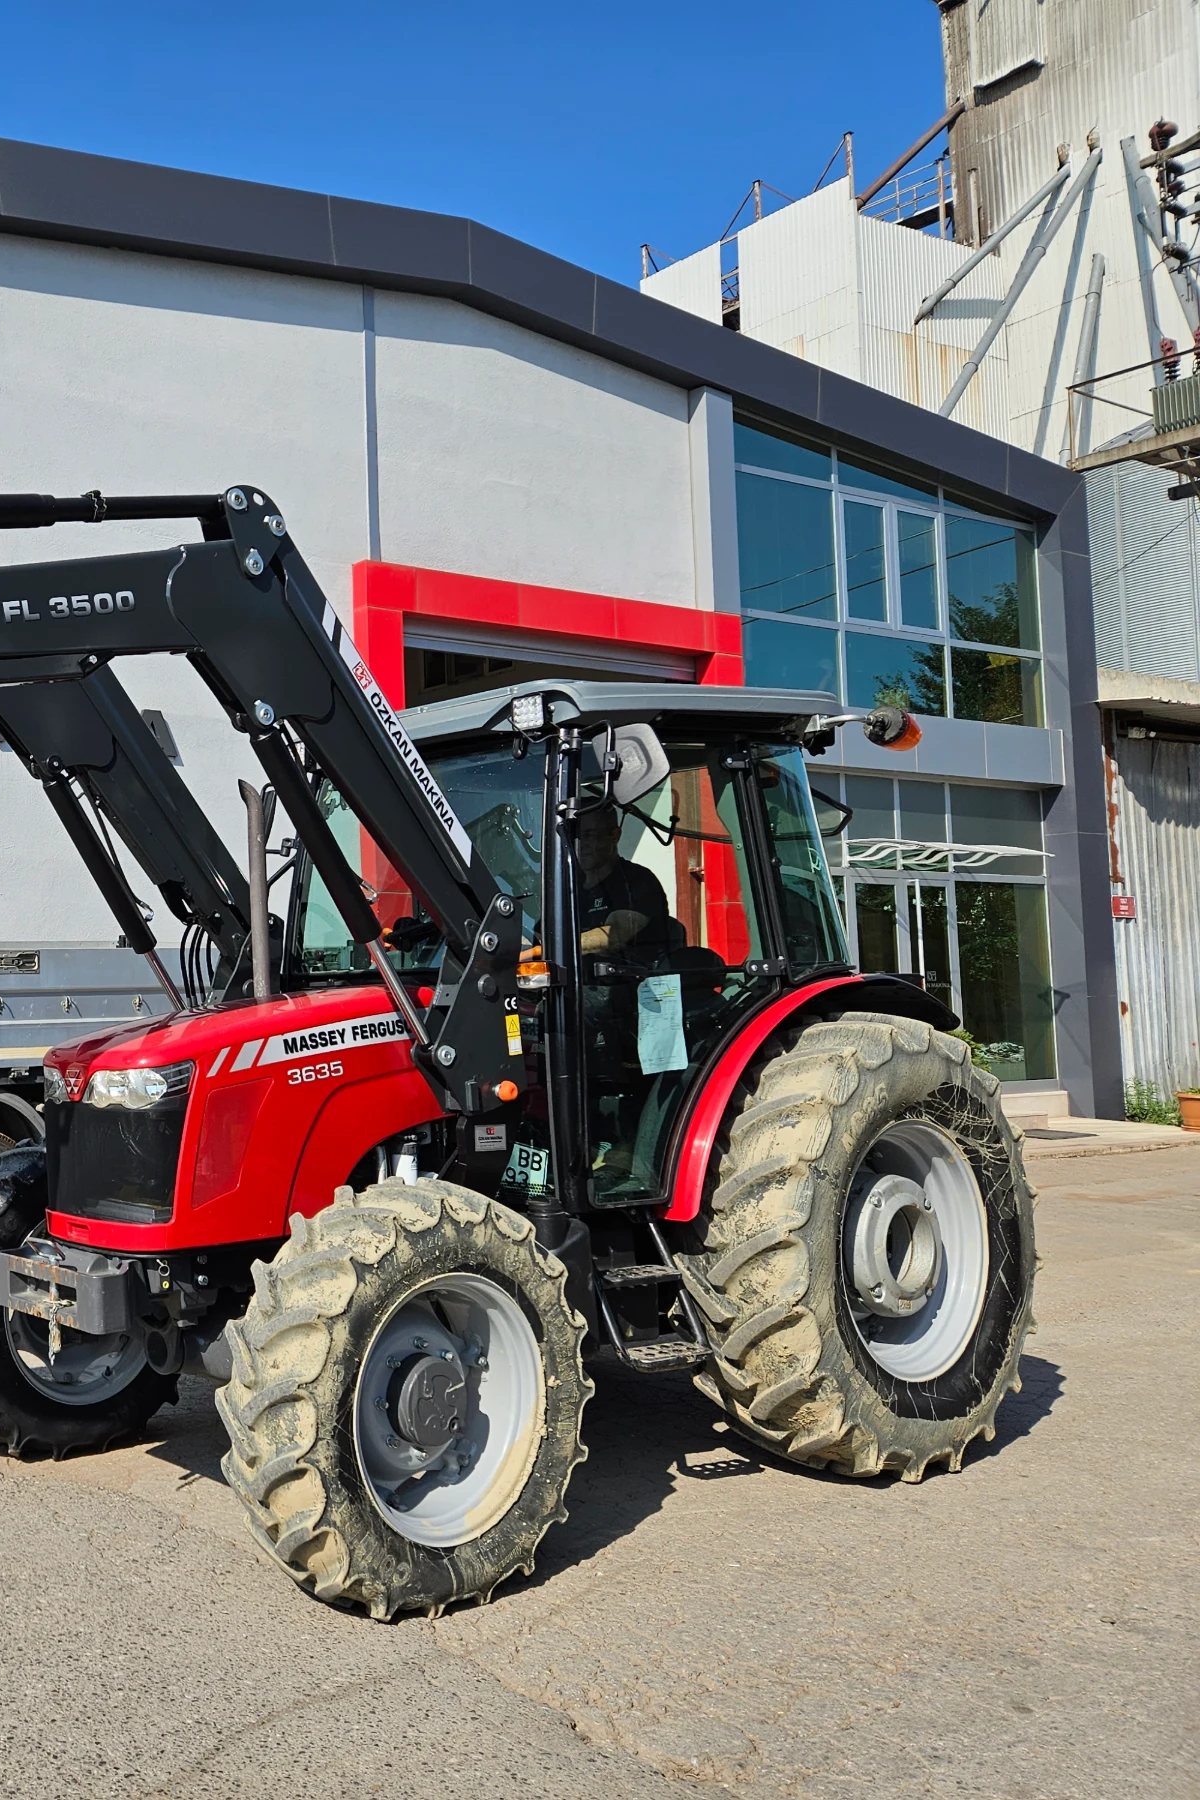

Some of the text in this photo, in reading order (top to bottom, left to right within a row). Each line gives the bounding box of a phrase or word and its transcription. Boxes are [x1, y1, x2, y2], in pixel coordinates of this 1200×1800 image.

[2, 590, 135, 623] FL 3500
[370, 691, 455, 832] ÖZKAN MAKİNA
[282, 1016, 413, 1055] MASSEY FERGUS
[286, 1060, 344, 1085] 3635
[518, 1147, 543, 1172] BB
